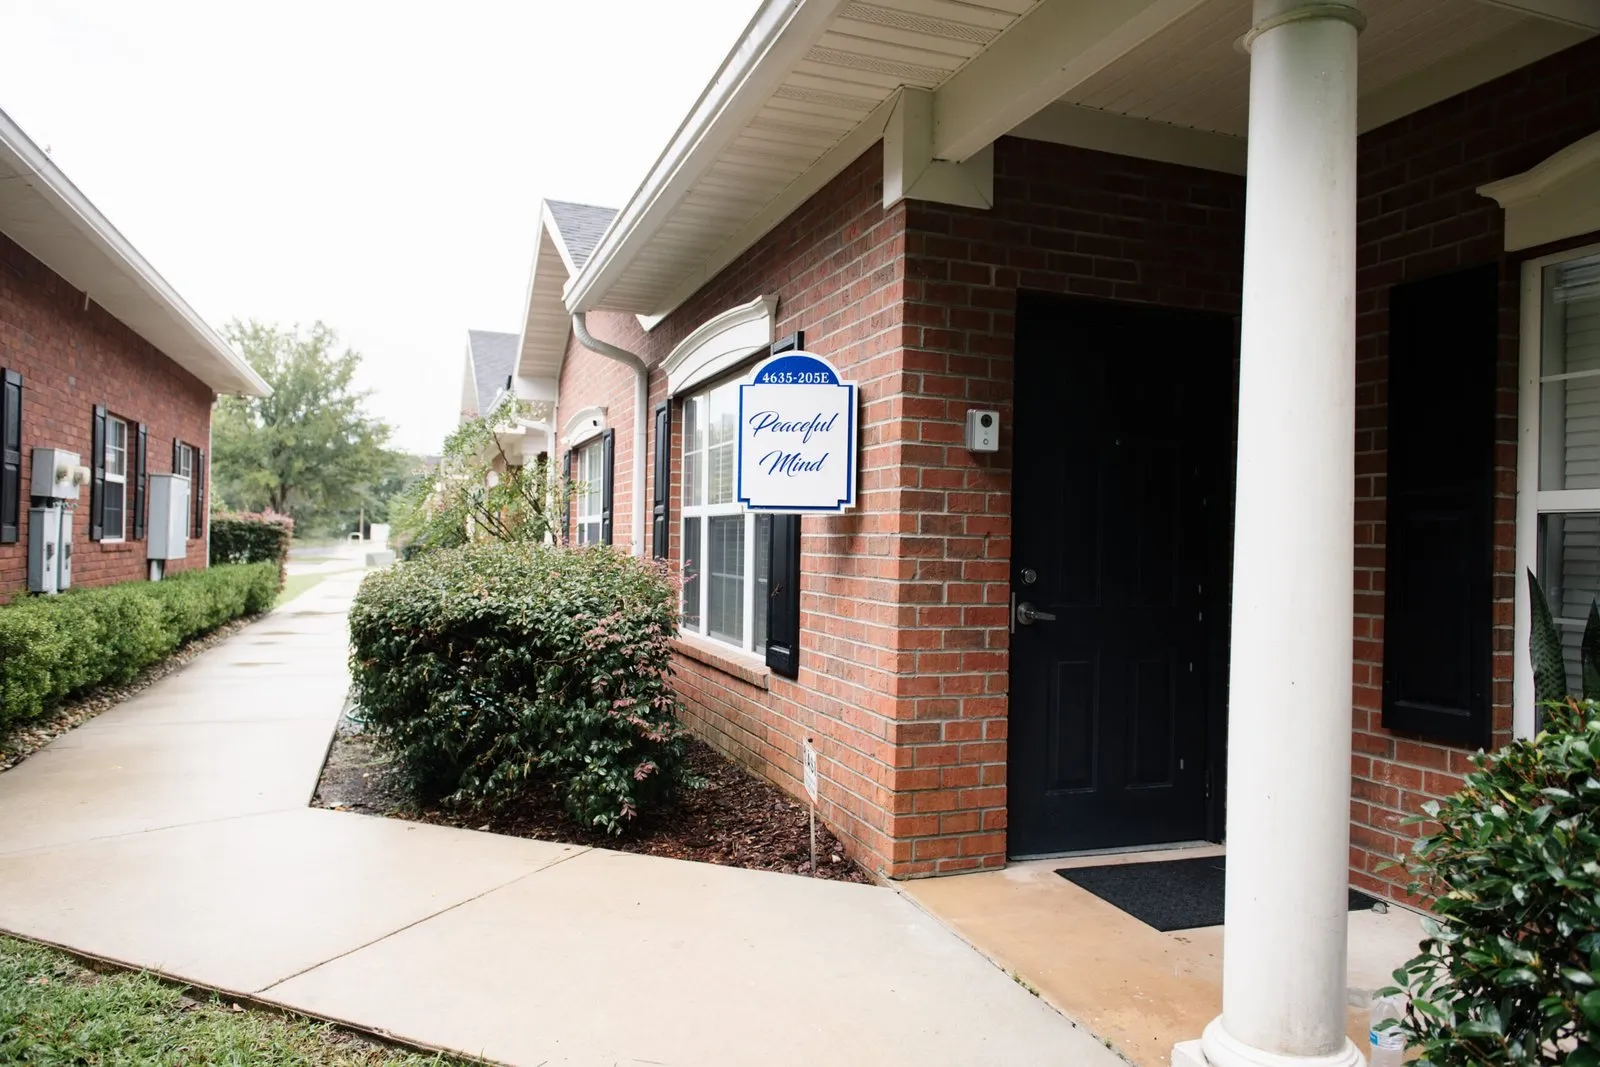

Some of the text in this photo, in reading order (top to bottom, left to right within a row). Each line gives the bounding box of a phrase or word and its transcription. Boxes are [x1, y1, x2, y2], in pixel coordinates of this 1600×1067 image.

[762, 372, 830, 384] 4635-205E
[749, 410, 839, 444] Peaceful
[759, 450, 829, 477] Mind
